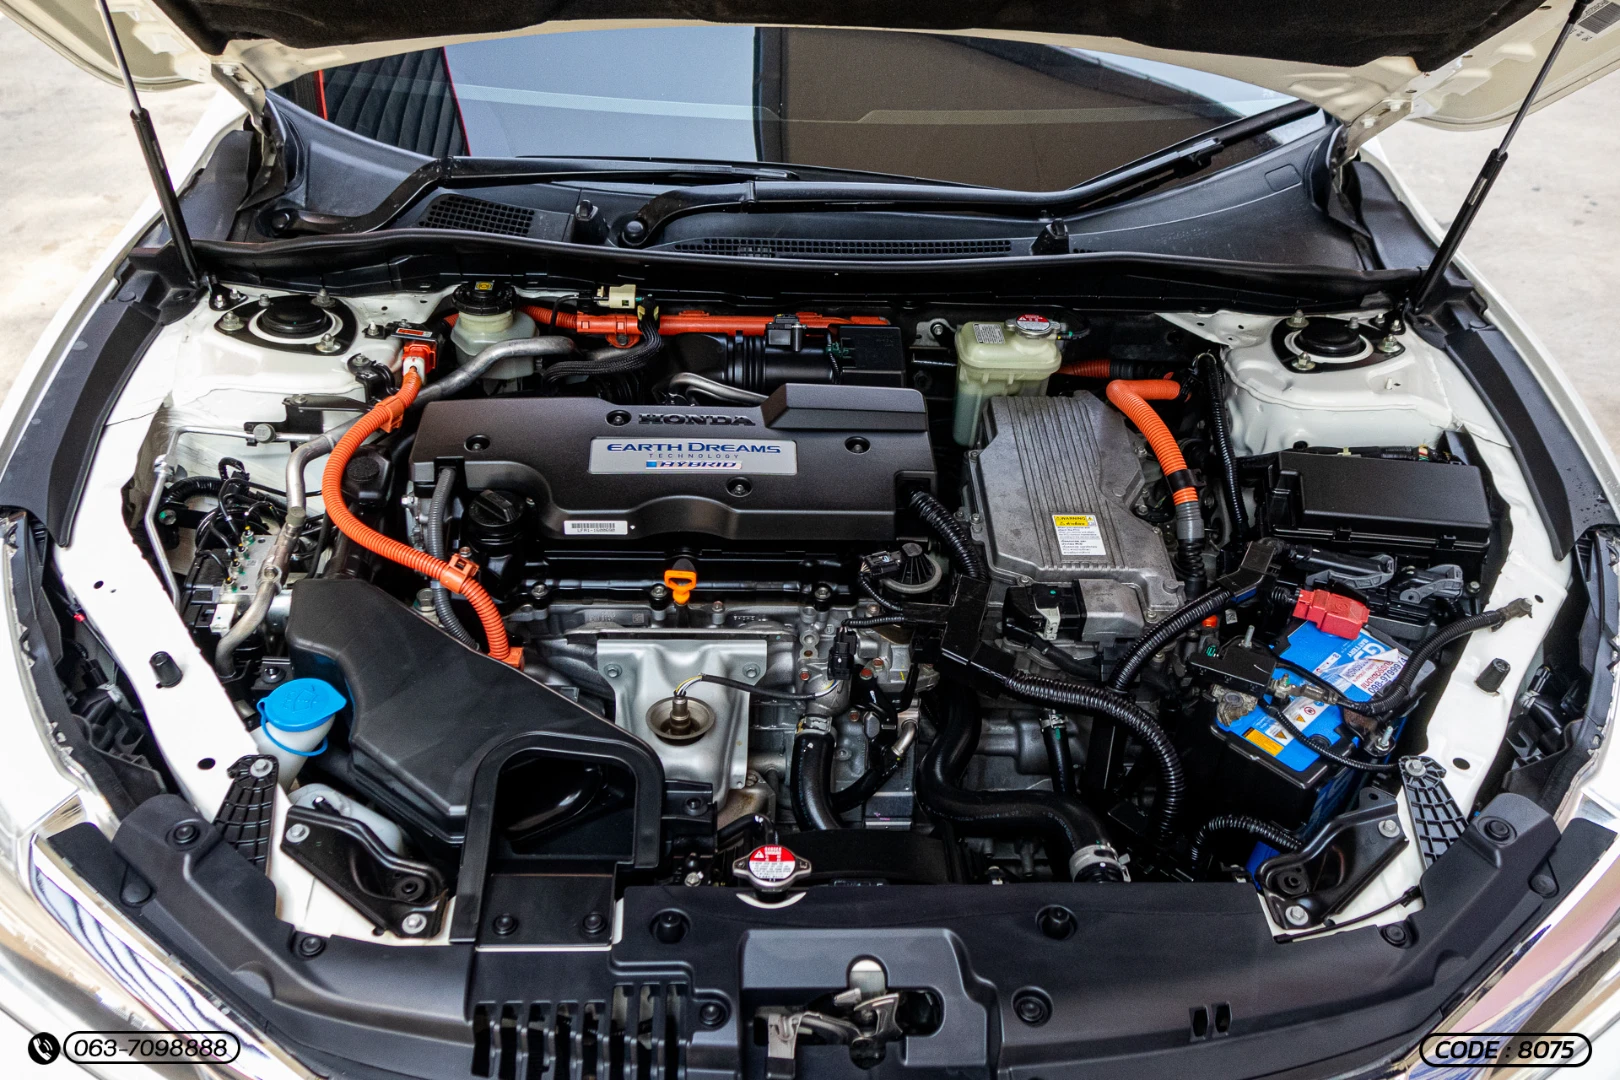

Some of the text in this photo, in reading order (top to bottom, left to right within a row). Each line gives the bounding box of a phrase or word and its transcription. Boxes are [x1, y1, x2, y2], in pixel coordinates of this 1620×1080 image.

[639, 413, 756, 426] HONDA
[607, 442, 781, 454] EARTH DREAMS
[1347, 638, 1369, 658] BATTERY
